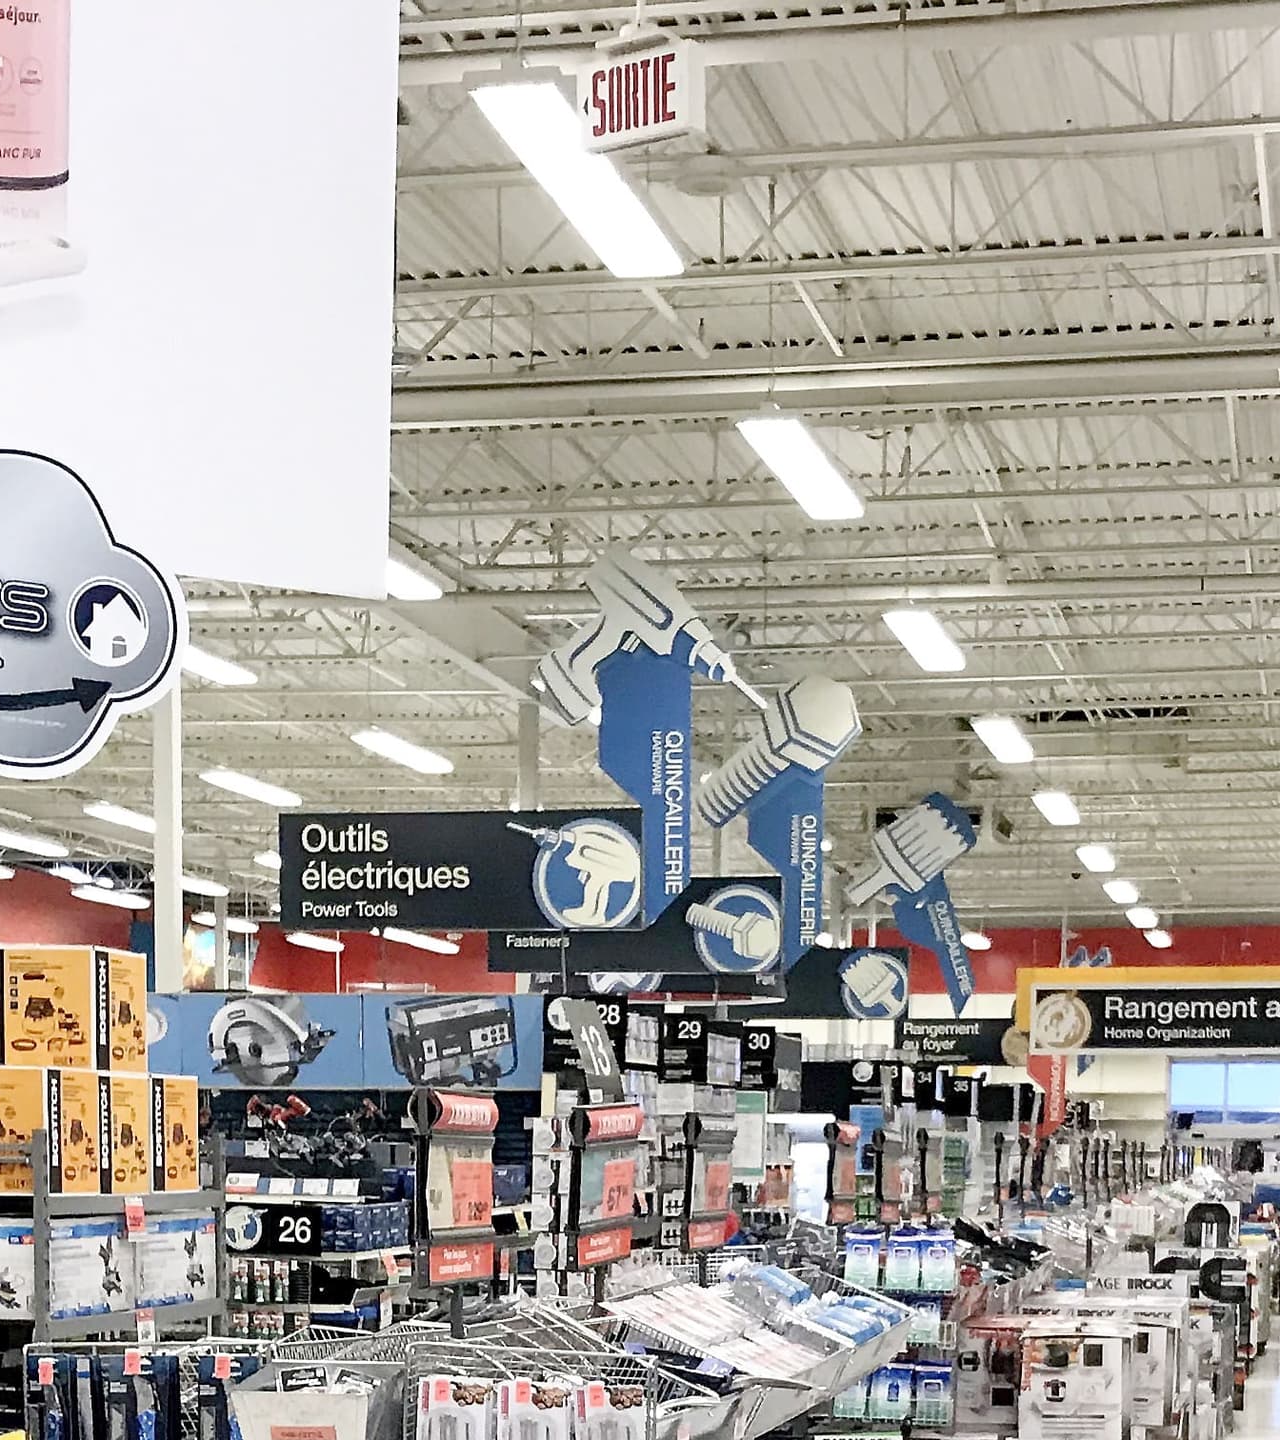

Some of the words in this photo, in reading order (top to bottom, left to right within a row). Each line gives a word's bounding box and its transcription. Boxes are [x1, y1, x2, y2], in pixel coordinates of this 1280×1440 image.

[592, 53, 676, 137] SORTIE
[22, 147, 42, 159] PUR
[664, 731, 685, 896] QUINCAILLERIE
[301, 823, 390, 853] Outils
[301, 860, 470, 896] électriques
[800, 814, 817, 946] QUINCAILLERIE
[301, 901, 352, 918] Power
[355, 901, 398, 918] Tools
[505, 934, 570, 949] Fasteners
[99, 959, 107, 1046] BOSTITCH
[597, 1003, 621, 1025] 28
[1104, 995, 1257, 1024] Rangement
[678, 1021, 702, 1039] 29
[748, 1033, 770, 1050] 30
[903, 1021, 980, 1037] Rangement
[1104, 1026, 1143, 1040] Home
[1146, 1026, 1232, 1042] Organization
[902, 1040, 919, 1050] au
[922, 1038, 958, 1053] foyer
[917, 1072, 932, 1084] 34
[51, 1078, 59, 1167] BOSTITCH
[101, 1083, 109, 1169] BOSTITCH
[154, 1085, 163, 1167] BOSTITCH
[278, 1216, 312, 1245] 26
